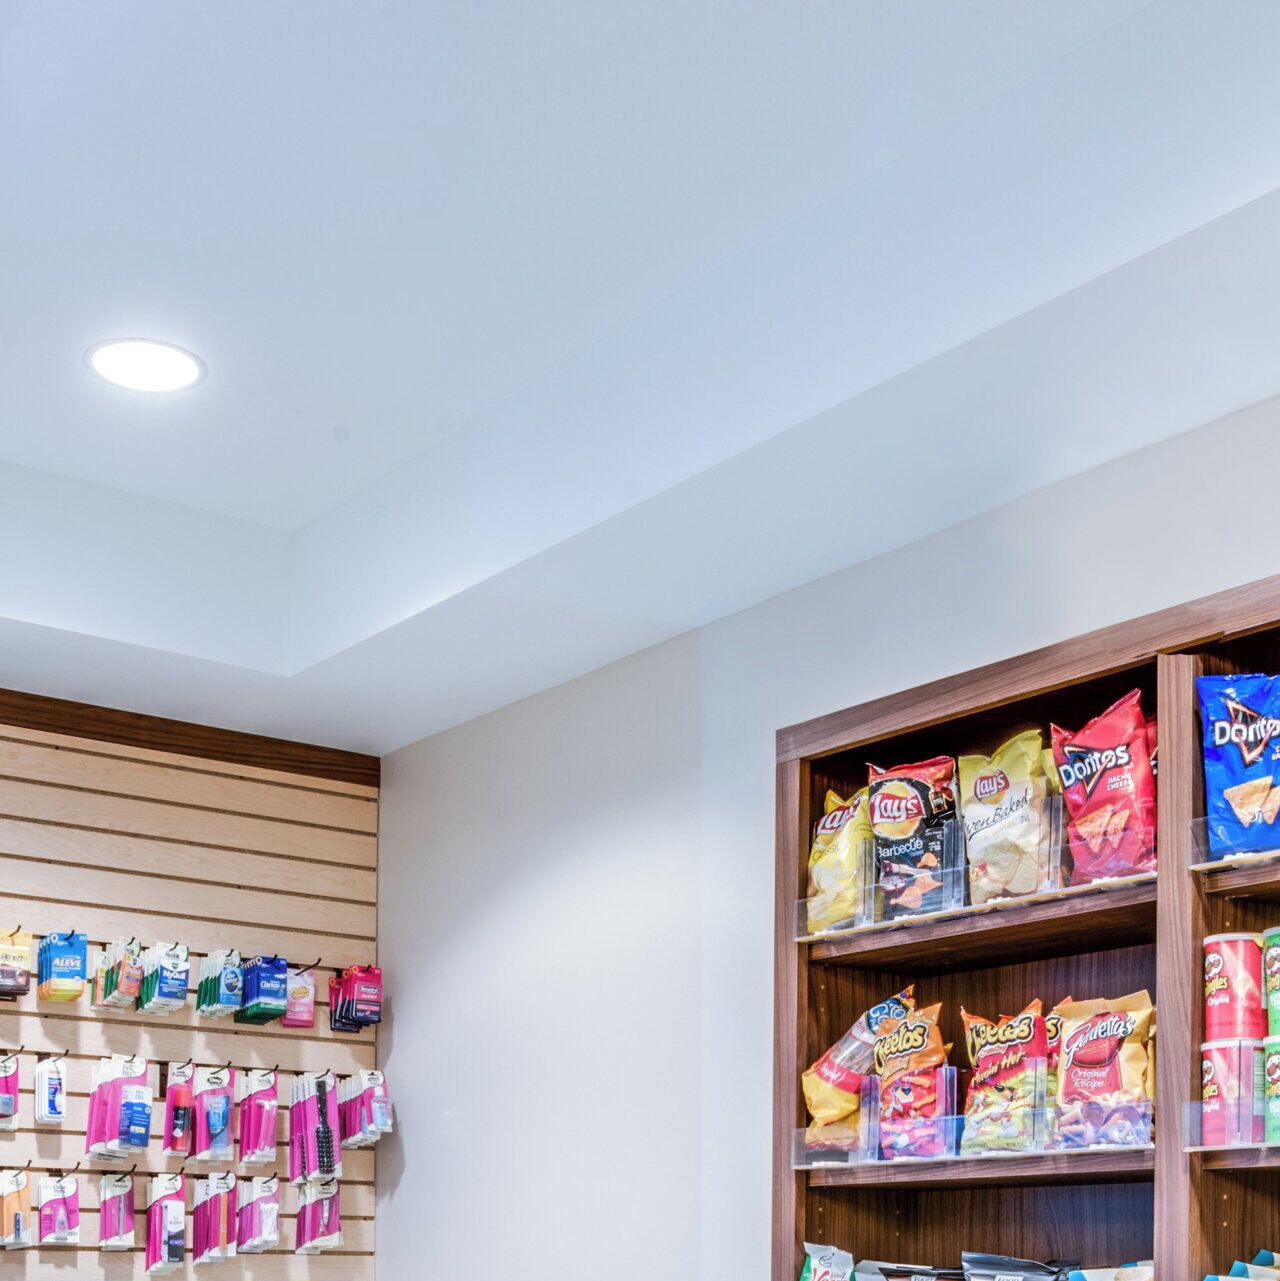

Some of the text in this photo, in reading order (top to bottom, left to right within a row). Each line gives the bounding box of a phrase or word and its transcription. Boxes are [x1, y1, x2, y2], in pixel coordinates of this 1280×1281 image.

[1058, 745, 1131, 787] Doritos
[974, 772, 1007, 798] Lay's
[872, 795, 919, 825] Lay's
[52, 958, 82, 967] ALEVE
